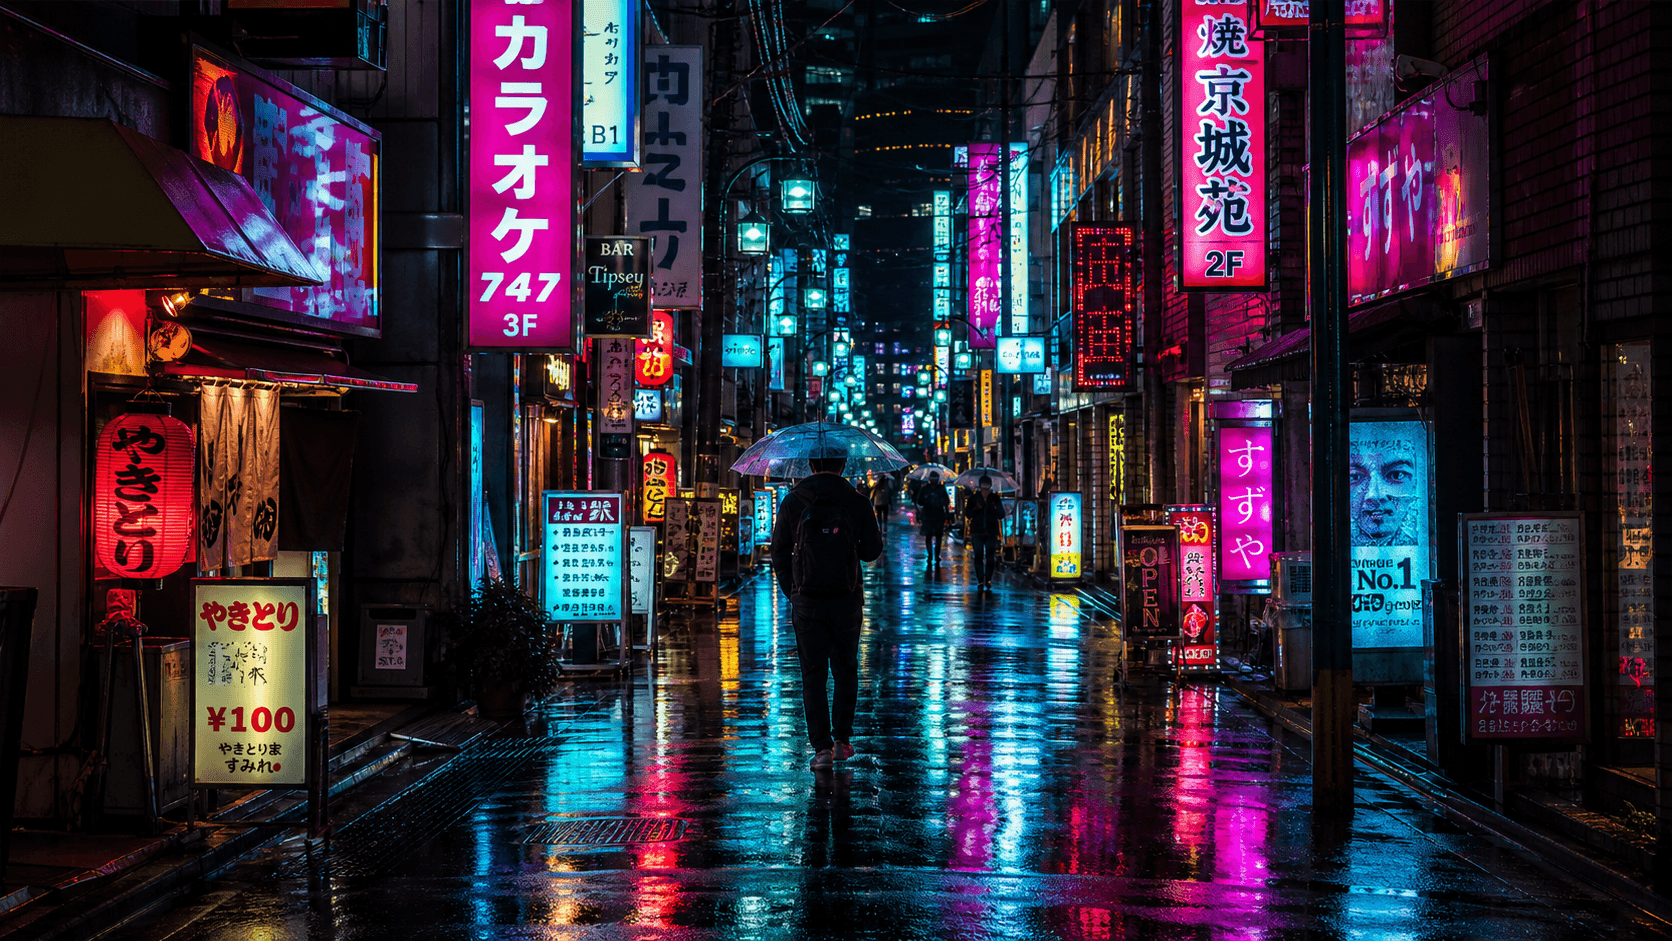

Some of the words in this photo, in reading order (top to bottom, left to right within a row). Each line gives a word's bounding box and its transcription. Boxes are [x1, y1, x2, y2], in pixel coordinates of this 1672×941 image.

[491, 0, 548, 263] カラオケ
[1195, 0, 1252, 235] 焼京城苑
[592, 125, 618, 145] B1
[1360, 143, 1422, 261] すずや
[600, 243, 634, 256] BAR
[1205, 250, 1244, 277] 2F
[480, 273, 560, 302] 747
[588, 265, 644, 290] Tipsey
[503, 313, 537, 337] 3F
[112, 425, 165, 572] やきとり
[1229, 440, 1265, 569] すずや
[1140, 547, 1161, 627] OPEN
[1357, 557, 1416, 590] No.1
[200, 601, 298, 632] やきとり
[207, 707, 295, 734] ¥100
